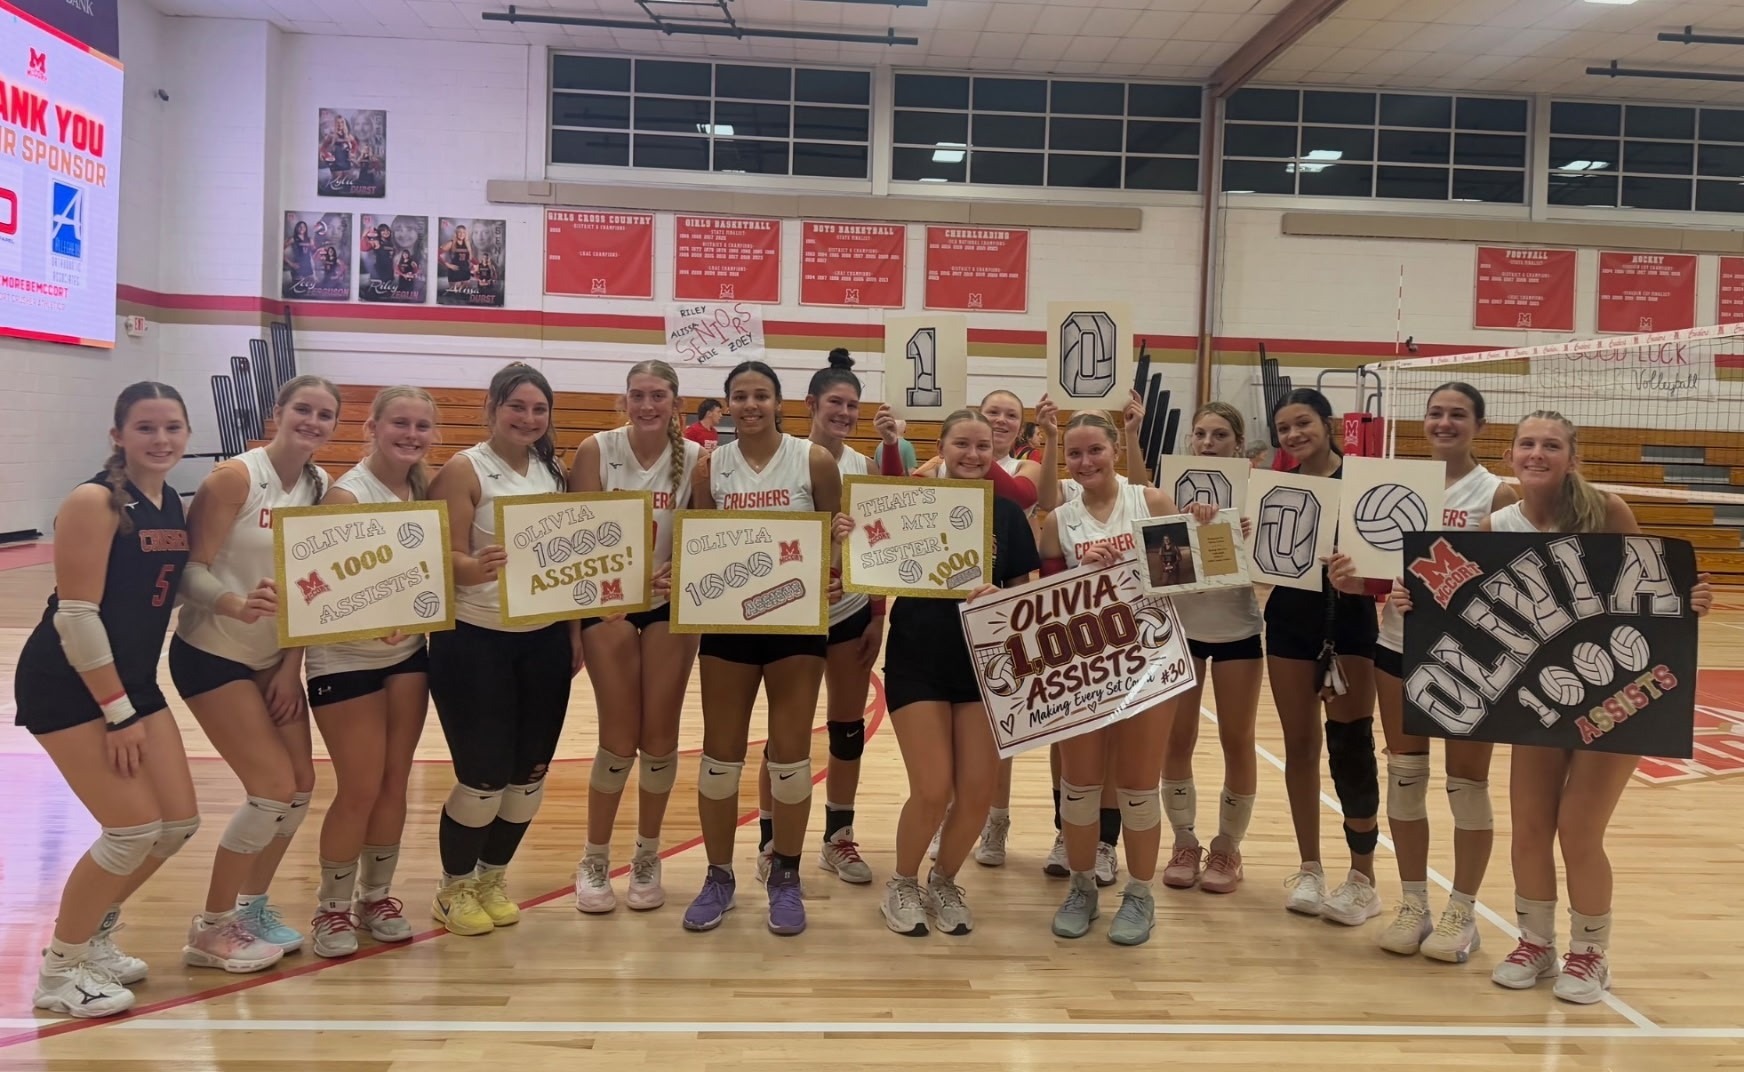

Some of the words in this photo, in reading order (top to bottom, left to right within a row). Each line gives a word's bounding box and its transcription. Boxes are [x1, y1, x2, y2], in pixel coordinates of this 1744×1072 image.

[55, 105, 104, 158] YOU
[22, 135, 107, 188] SPONSOR
[548, 212, 574, 221] GIRLS
[578, 214, 605, 223] CROSS
[609, 216, 651, 225] COUNTRY
[685, 219, 711, 227] GIRLS
[715, 220, 771, 230] BASKETBALL
[813, 225, 835, 233] BOYS
[839, 226, 894, 235] BASKETBALL
[945, 230, 1010, 240] CHEERLEADING
[1506, 250, 1548, 259] FOOTBALL
[1632, 256, 1664, 264] HOCKEY
[0, 274, 69, 298] MOREBEMCCORT
[680, 306, 706, 318] RILEY
[671, 322, 699, 339] ALISSA
[675, 303, 751, 361] SENIORS
[728, 332, 752, 352] ZOEY
[906, 327, 942, 407] 1
[1060, 312, 1117, 397] 0
[1639, 343, 1687, 364] LUCK
[1633, 369, 1699, 397] Volleyball
[723, 489, 790, 510] CRUSHERS
[857, 487, 936, 517] THAT'S
[1442, 507, 1467, 527] ERS
[291, 519, 386, 560] OLIVIA
[513, 505, 595, 549] OLIVIA
[901, 512, 938, 531] MY
[1253, 485, 1322, 579] 0
[686, 527, 772, 555] OLIVIA
[861, 532, 949, 569] SISTER!
[330, 544, 393, 580] 1000
[530, 546, 633, 595] ASSISTS!
[928, 549, 979, 586] 1000
[151, 564, 175, 607] 5
[320, 561, 430, 625] ASSISTS!
[744, 581, 802, 617] ASSISTS
[1011, 575, 1117, 632] OLIVIA
[1004, 601, 1139, 679] 1,000
[1404, 535, 1684, 736] OLIVIA
[1027, 645, 1146, 710] ASSISTS
[1160, 659, 1186, 685] #30
[1029, 700, 1072, 727] Making
[1074, 688, 1104, 707] Every
[1106, 681, 1123, 694] Set
[1574, 664, 1678, 744] ASSISTS
